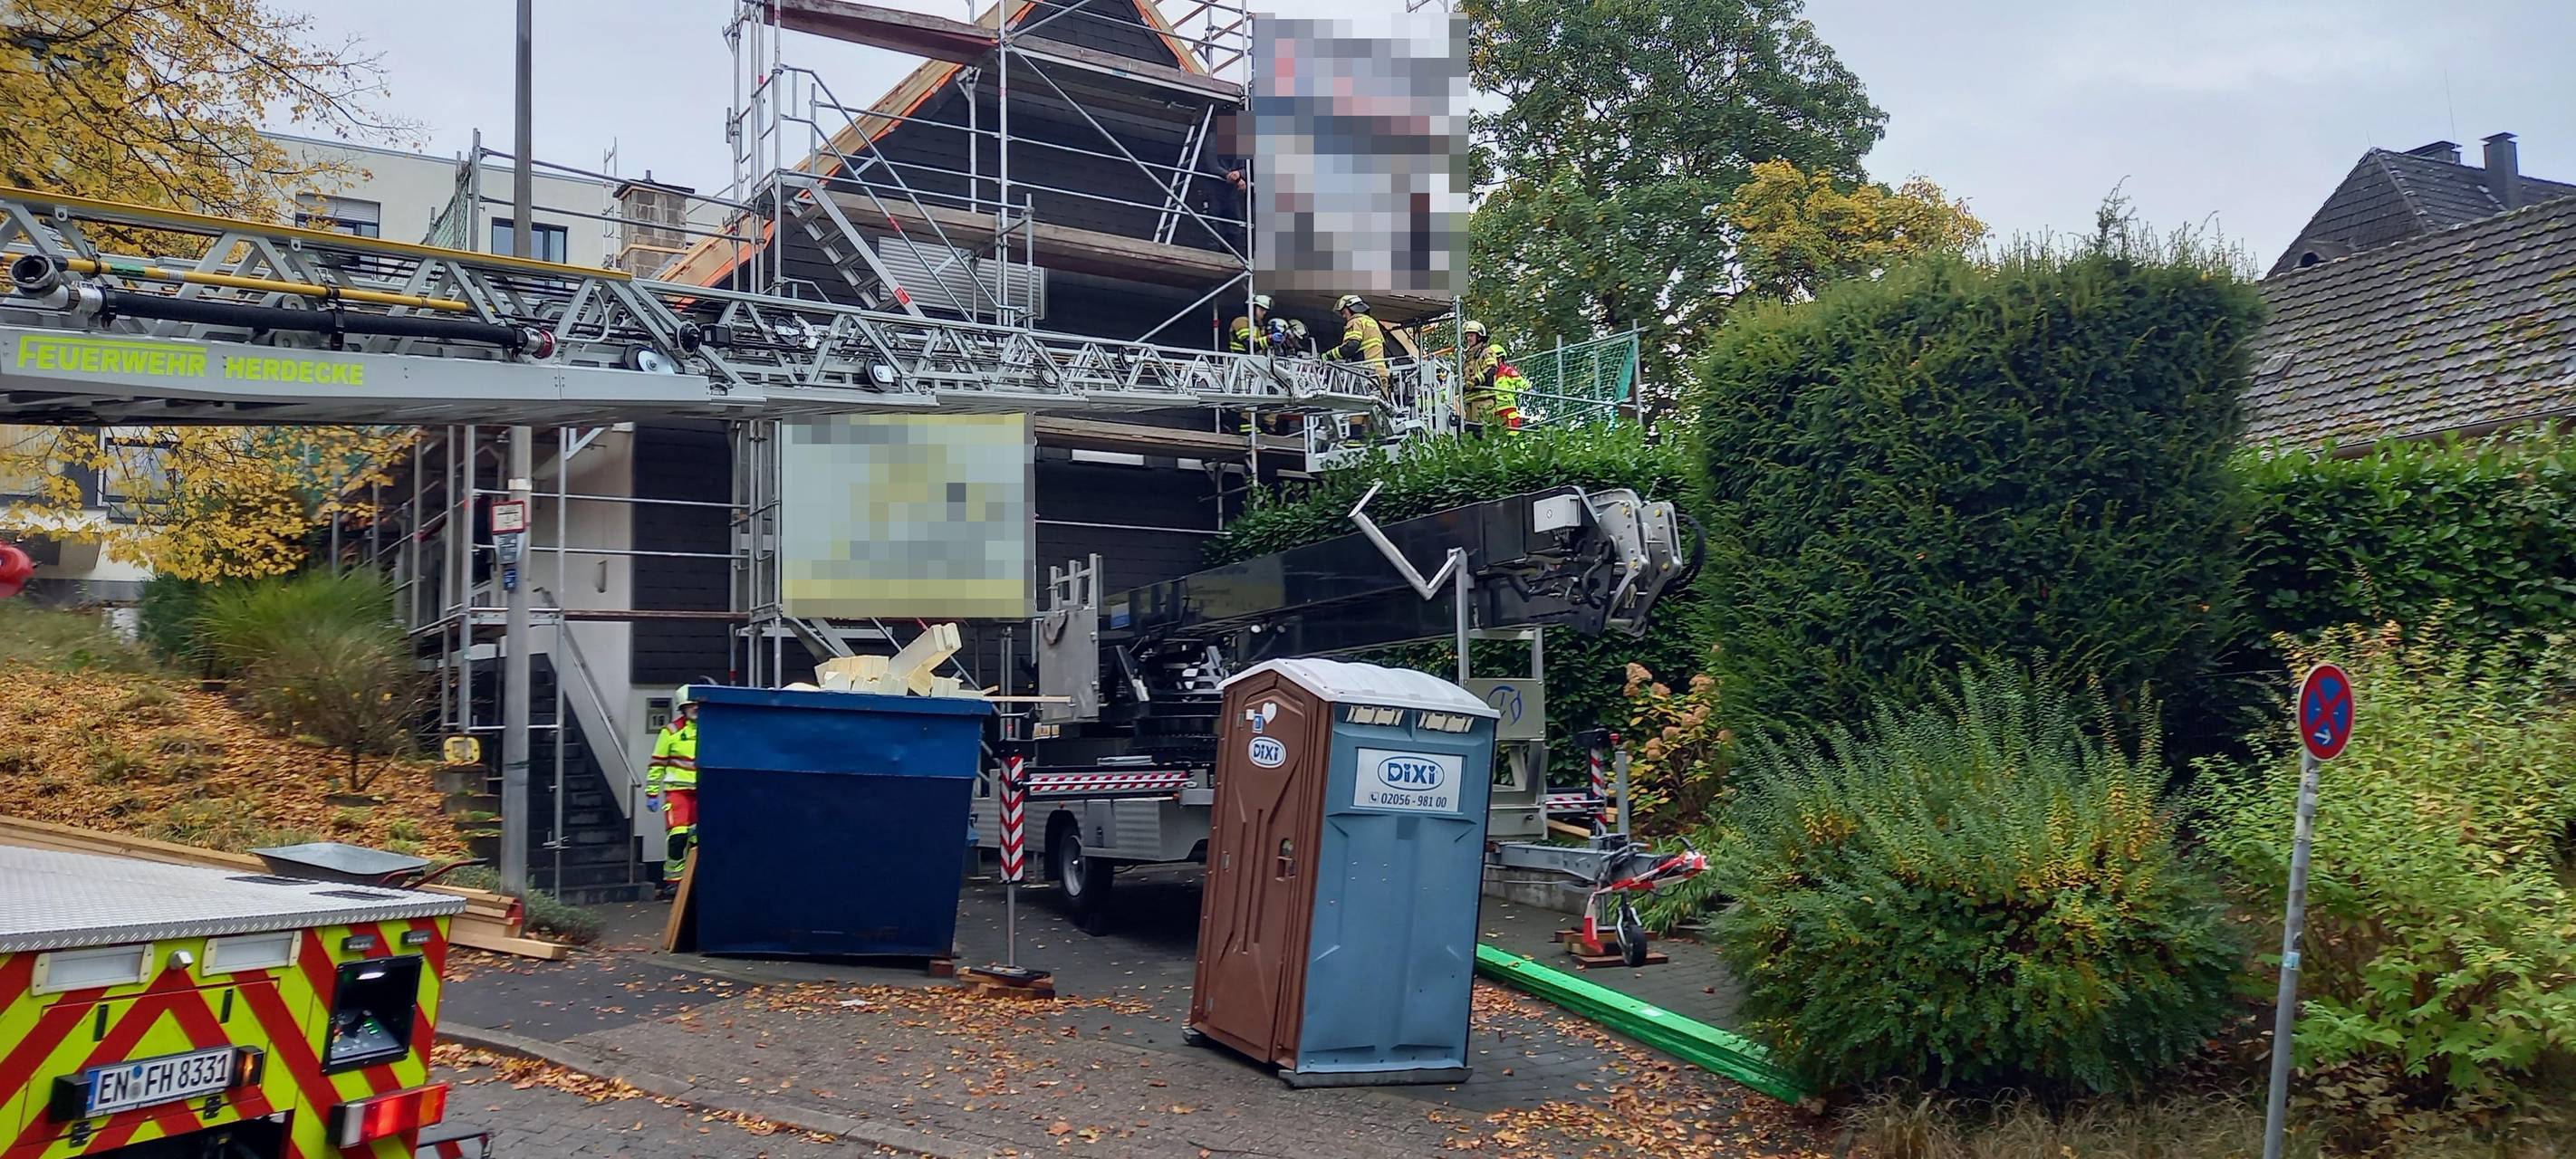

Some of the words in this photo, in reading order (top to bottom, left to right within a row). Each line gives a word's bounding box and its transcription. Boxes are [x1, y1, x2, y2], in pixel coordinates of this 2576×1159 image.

[18, 336, 206, 378] FEUERWEHR
[225, 356, 363, 386] HERDECKE
[1381, 792, 1410, 806] 02056
[1418, 795, 1433, 808] 981
[1436, 797, 1447, 809] 00
[98, 1069, 130, 1105] EN
[145, 1063, 174, 1097] FH
[178, 1053, 228, 1089] 8331
